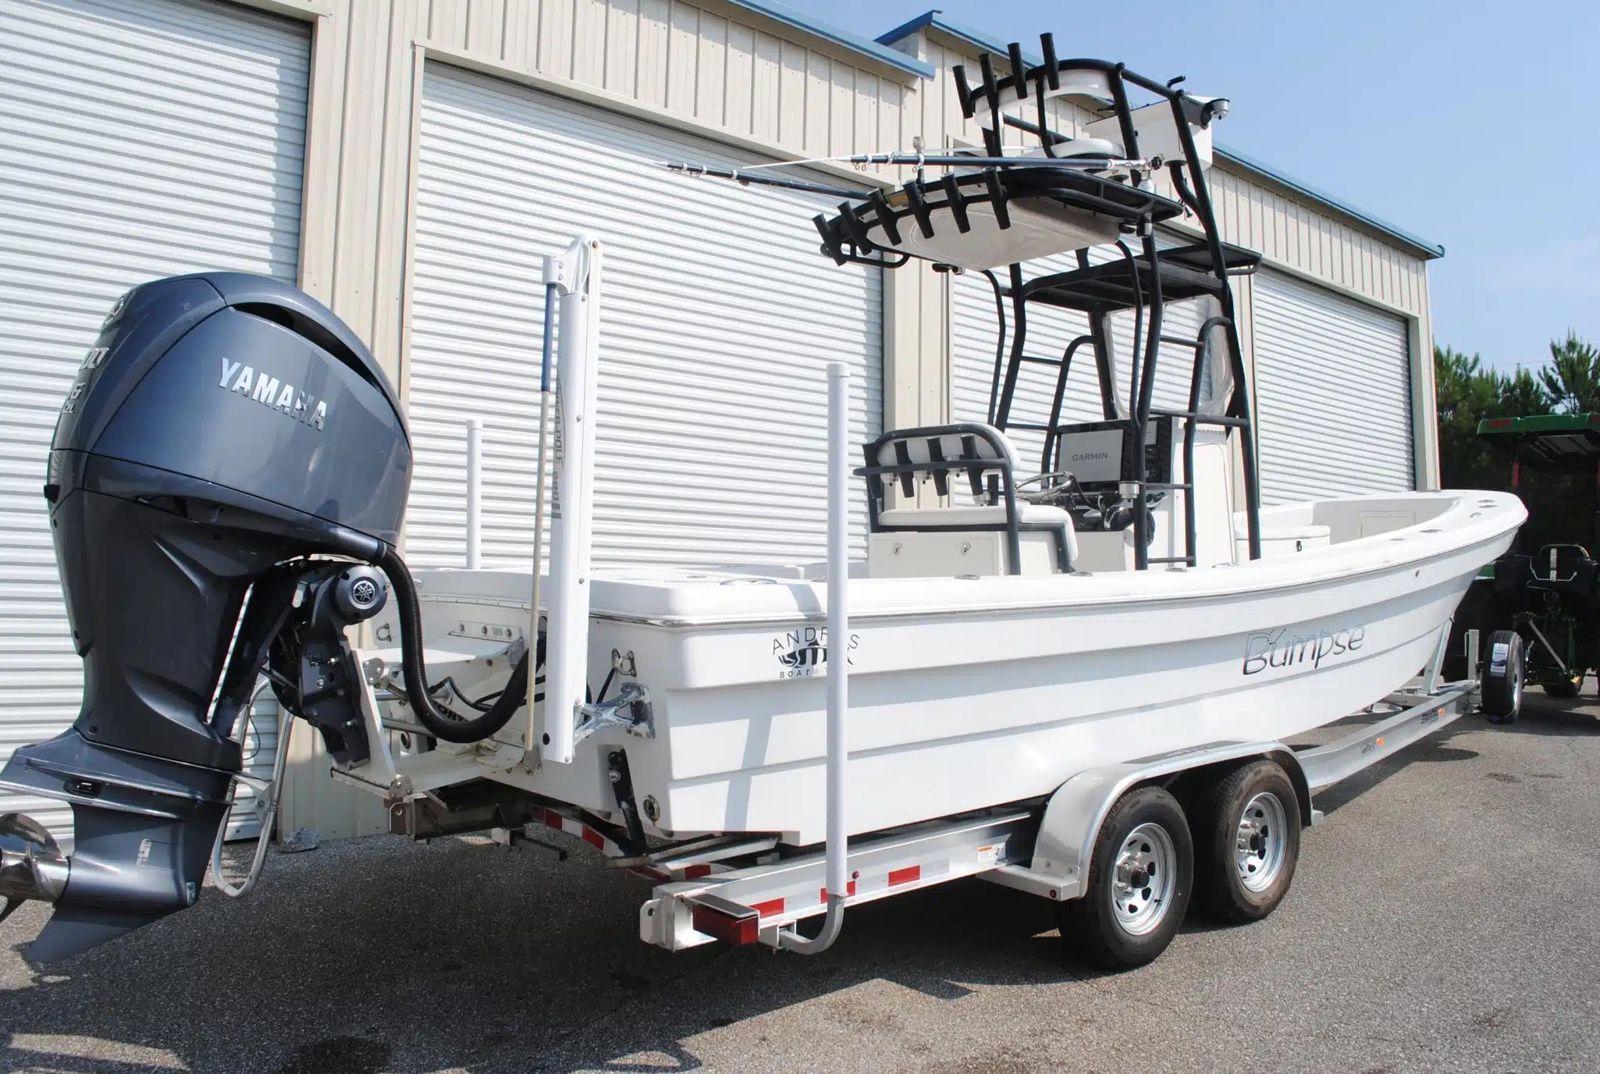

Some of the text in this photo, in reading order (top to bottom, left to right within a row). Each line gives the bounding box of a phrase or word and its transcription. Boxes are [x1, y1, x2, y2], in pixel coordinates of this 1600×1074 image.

[218, 357, 328, 432] YAMAHA
[1072, 451, 1109, 462] GARMIN
[772, 626, 861, 655] ANDRS
